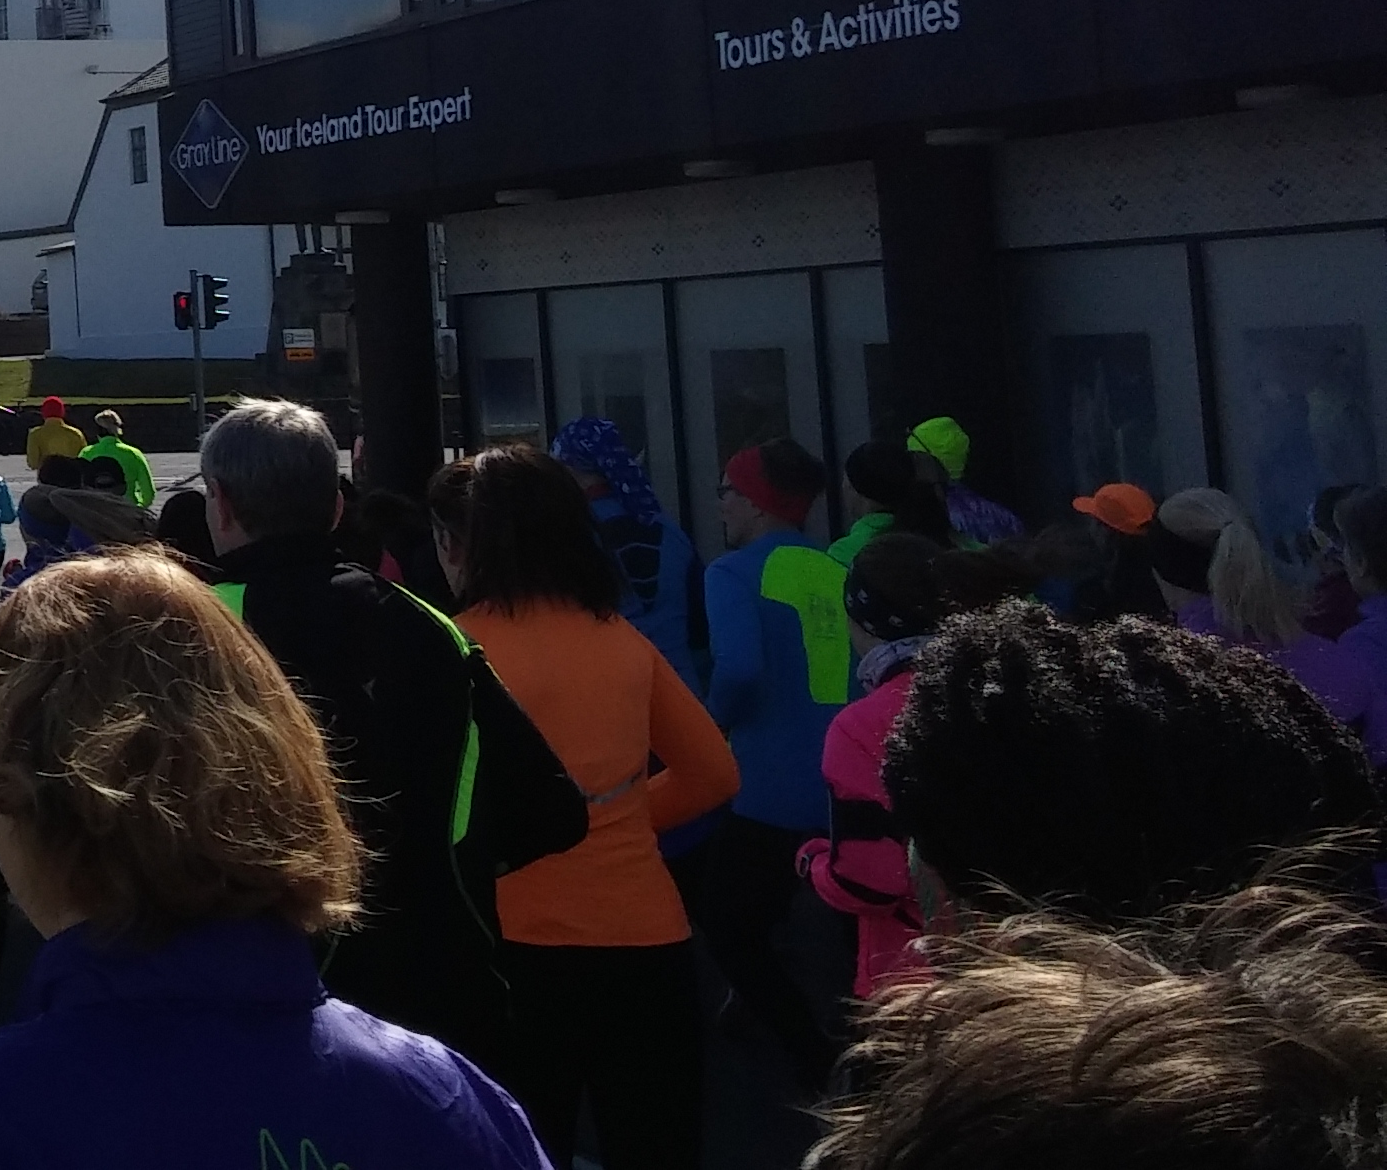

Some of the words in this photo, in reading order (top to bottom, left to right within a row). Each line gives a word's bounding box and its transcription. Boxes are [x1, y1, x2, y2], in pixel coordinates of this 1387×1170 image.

[714, 28, 785, 71] Tours
[790, 15, 812, 59] &
[256, 124, 293, 155] Your
[296, 105, 363, 149] Iceland
[364, 102, 405, 137] Tour
[408, 86, 473, 133] Expert
